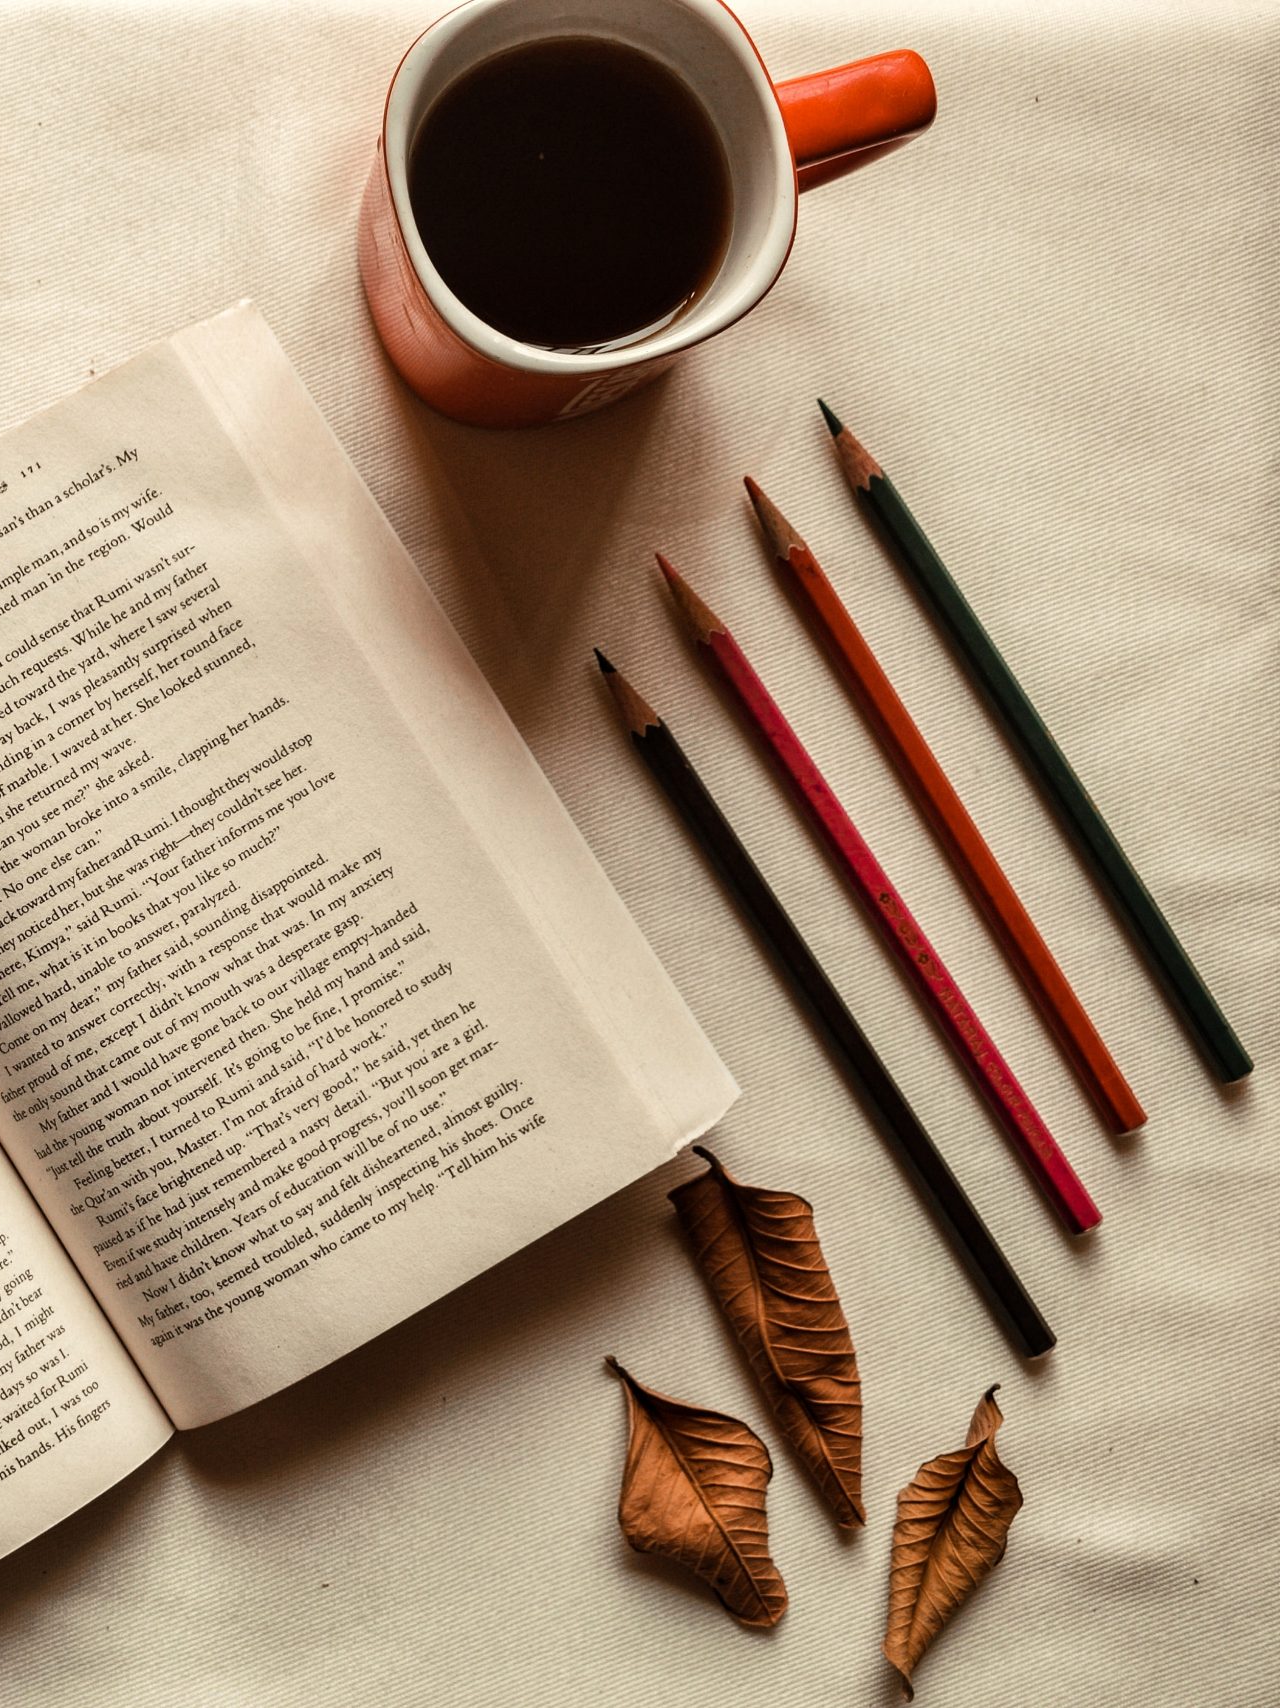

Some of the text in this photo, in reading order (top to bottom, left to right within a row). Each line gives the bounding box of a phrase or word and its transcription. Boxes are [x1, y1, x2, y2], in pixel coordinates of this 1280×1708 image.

[20, 461, 42, 478] 171
[24, 500, 54, 521] than
[54, 495, 63, 504] a
[115, 448, 138, 467] My
[16, 819, 41, 842] you
[41, 807, 61, 824] see
[95, 774, 116, 791] she
[116, 749, 155, 778] asked.
[72, 1165, 115, 1191] Feeling
[110, 1145, 152, 1170] better,
[149, 1136, 159, 1149] I
[159, 1111, 201, 1143] turned
[201, 1106, 216, 1119] to
[215, 1079, 256, 1110] Rumi
[256, 1064, 280, 1087] and
[280, 1049, 310, 1072] said,
[333, 1024, 352, 1038] be
[351, 988, 405, 1028] honored
[404, 983, 419, 996] to
[420, 961, 453, 988] study
[150, 1329, 175, 1348] again
[172, 1324, 185, 1336] it
[182, 1316, 205, 1331] was
[203, 1305, 225, 1321] the
[223, 1284, 265, 1314] young
[262, 1258, 310, 1288] woman
[309, 1241, 338, 1261] who
[339, 1221, 372, 1245] came
[371, 1212, 387, 1225] to
[387, 1198, 407, 1216] my
[406, 1182, 439, 1203] help.
[469, 1144, 499, 1165] him
[496, 1132, 518, 1149] his
[517, 1113, 547, 1135] wife
[14, 1441, 55, 1469] hands.
[54, 1424, 77, 1443] His
[76, 1399, 111, 1429] fingers
